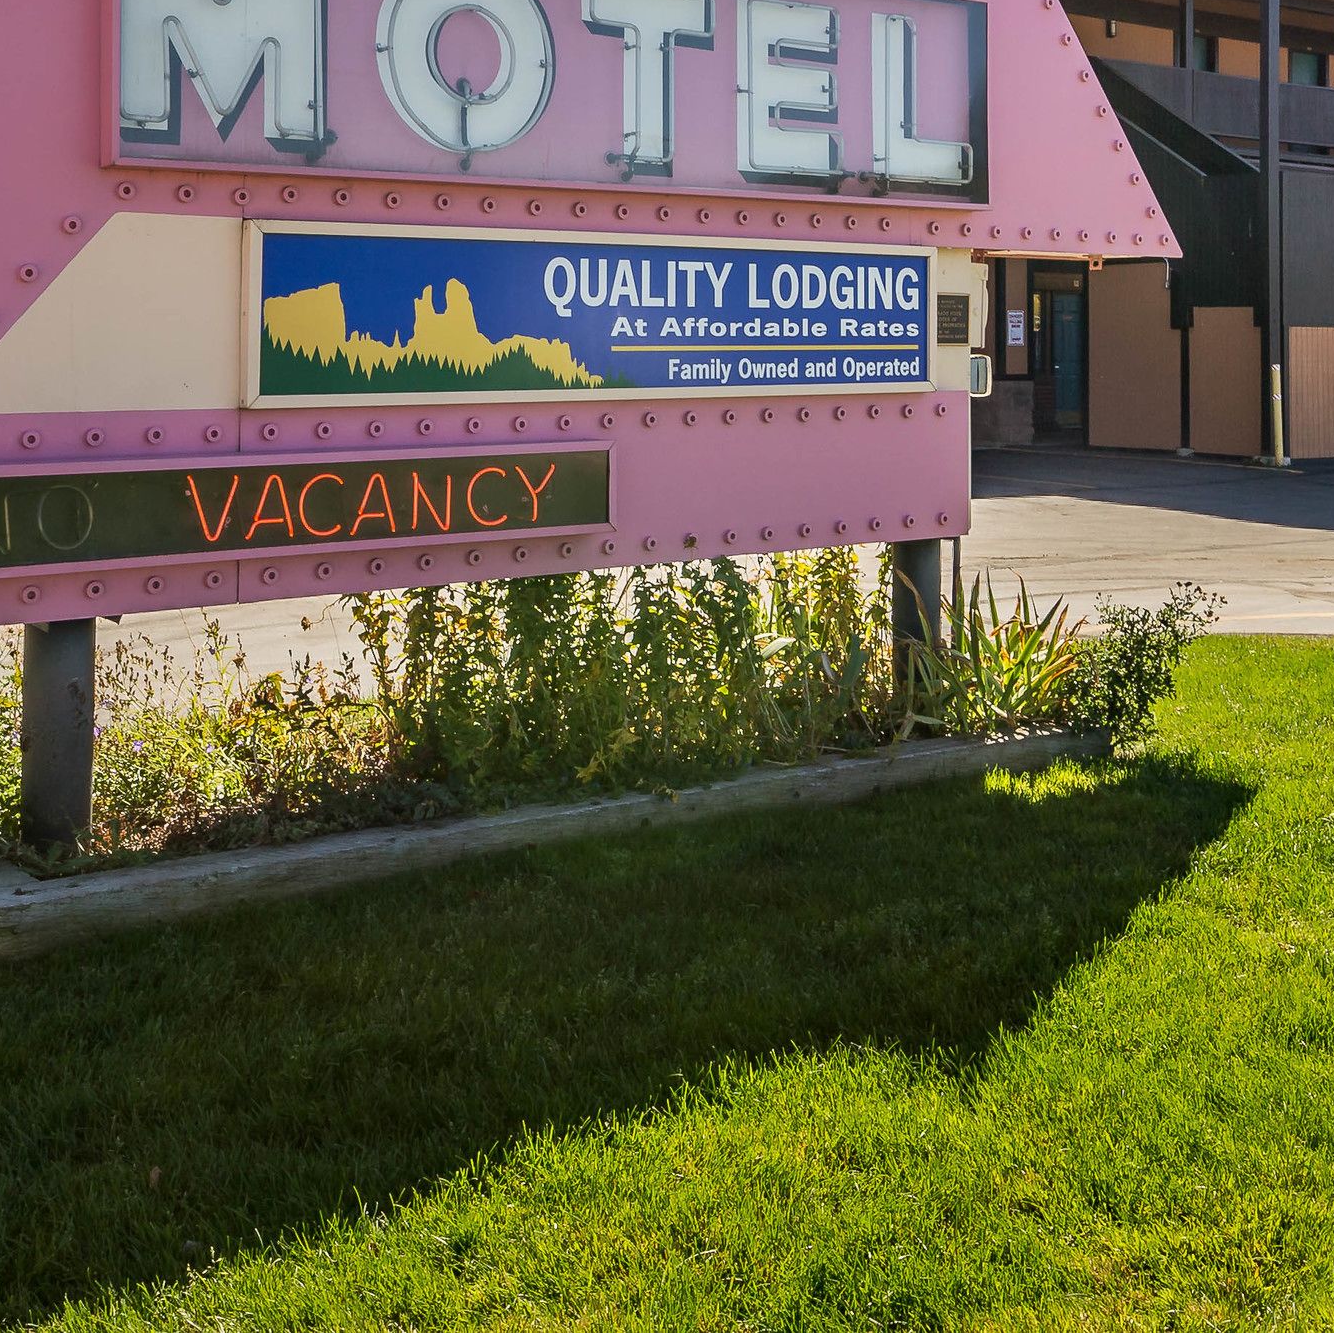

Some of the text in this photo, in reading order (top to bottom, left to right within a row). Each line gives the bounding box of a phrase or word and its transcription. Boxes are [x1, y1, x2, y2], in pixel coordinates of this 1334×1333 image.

[543, 256, 920, 317] QUALITY LODGING
[610, 316, 648, 337] At
[659, 317, 828, 337] Affordable
[840, 318, 920, 337] Rates
[668, 356, 920, 384] Family Owned and Operated
[186, 463, 556, 542] VACANCY
